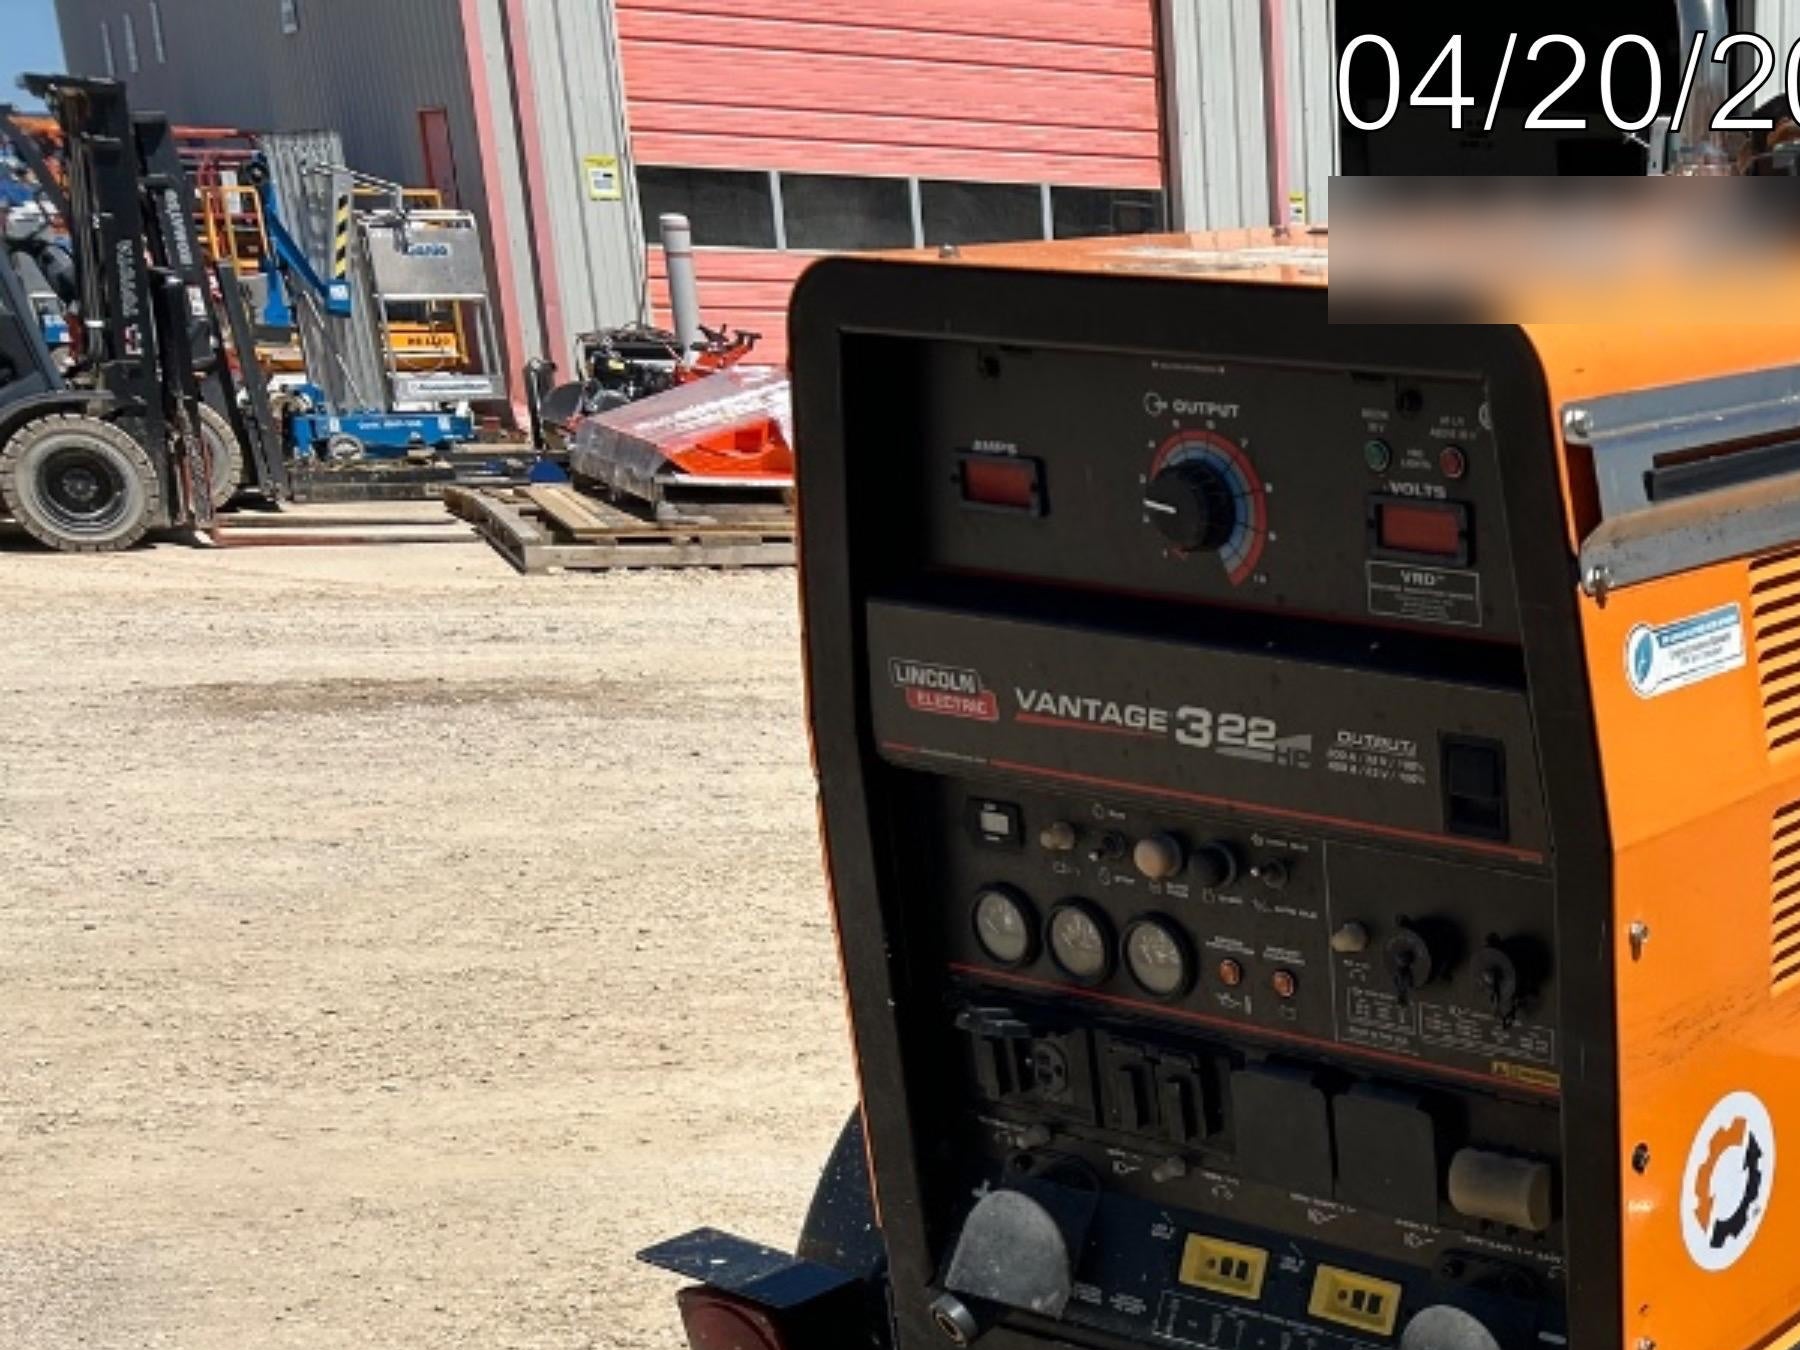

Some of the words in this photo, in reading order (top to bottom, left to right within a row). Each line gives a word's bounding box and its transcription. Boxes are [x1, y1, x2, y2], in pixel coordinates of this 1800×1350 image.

[1172, 398, 1241, 419] OUTPUT
[1388, 480, 1448, 499] VOLTS
[895, 663, 977, 694] LINCOLN
[916, 691, 988, 715] ELECTRIC
[1014, 686, 1169, 734] VANTAGE
[1175, 704, 1277, 751] 322
